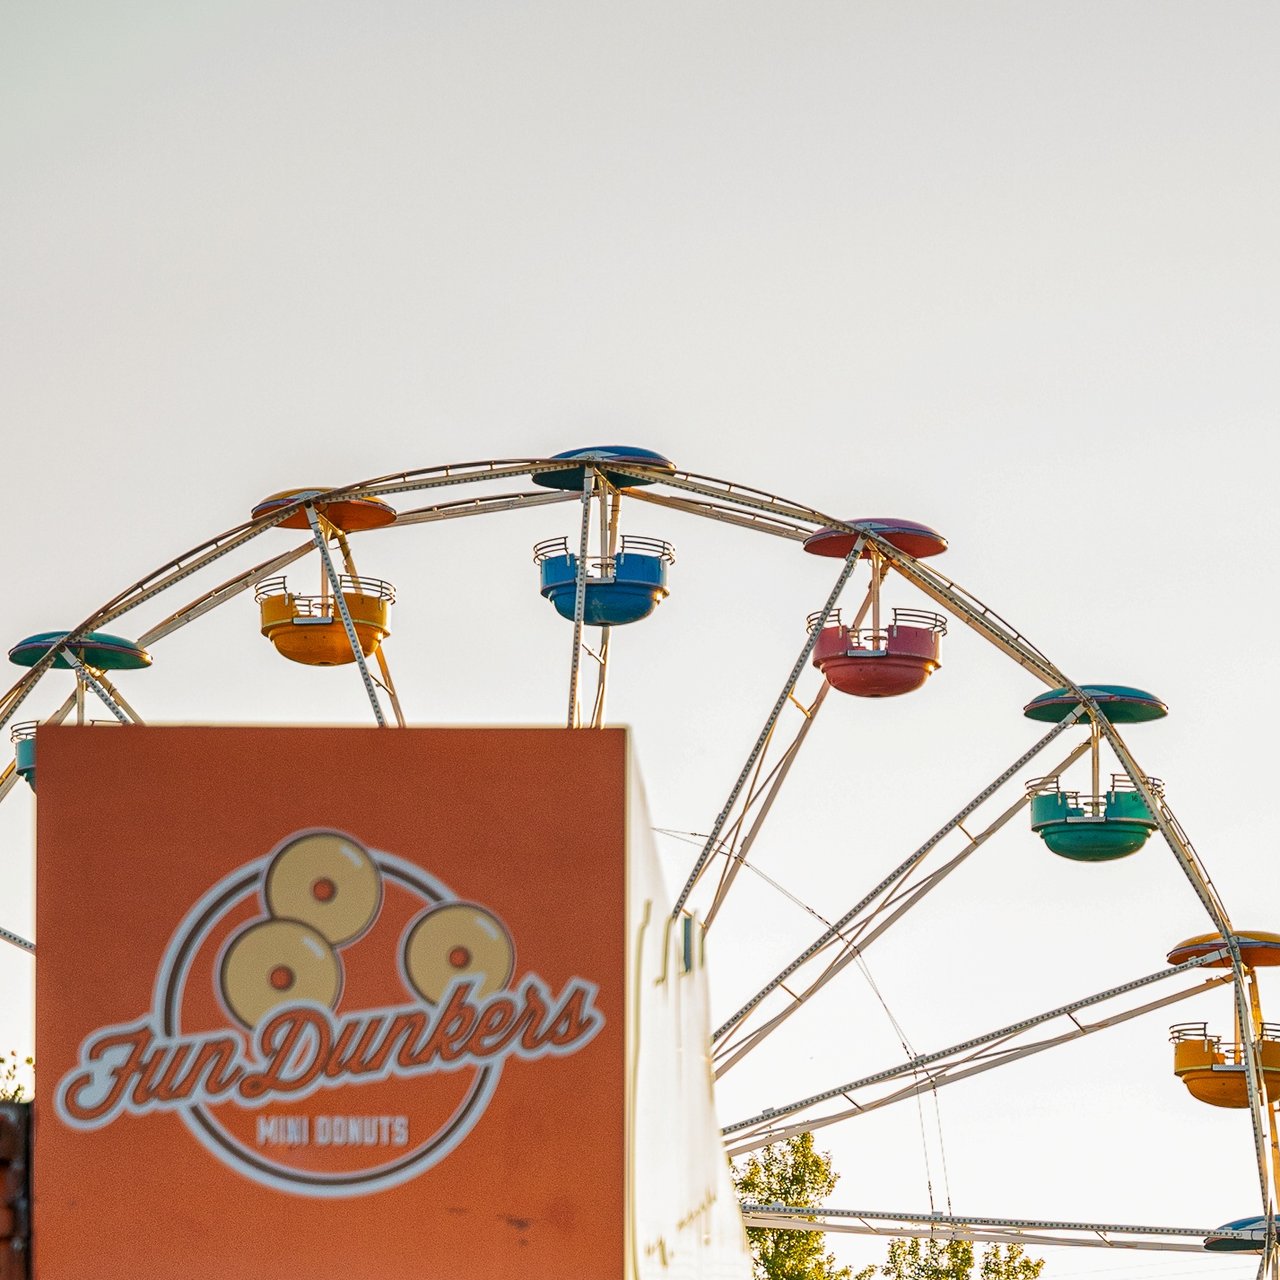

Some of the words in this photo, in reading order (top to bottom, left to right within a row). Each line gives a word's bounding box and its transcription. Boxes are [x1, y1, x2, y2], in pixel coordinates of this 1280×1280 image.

[58, 1022, 243, 1125] Fun
[238, 980, 601, 1101] Dunkers
[257, 1115, 310, 1148] MINI
[314, 1115, 409, 1147] DONUTS
